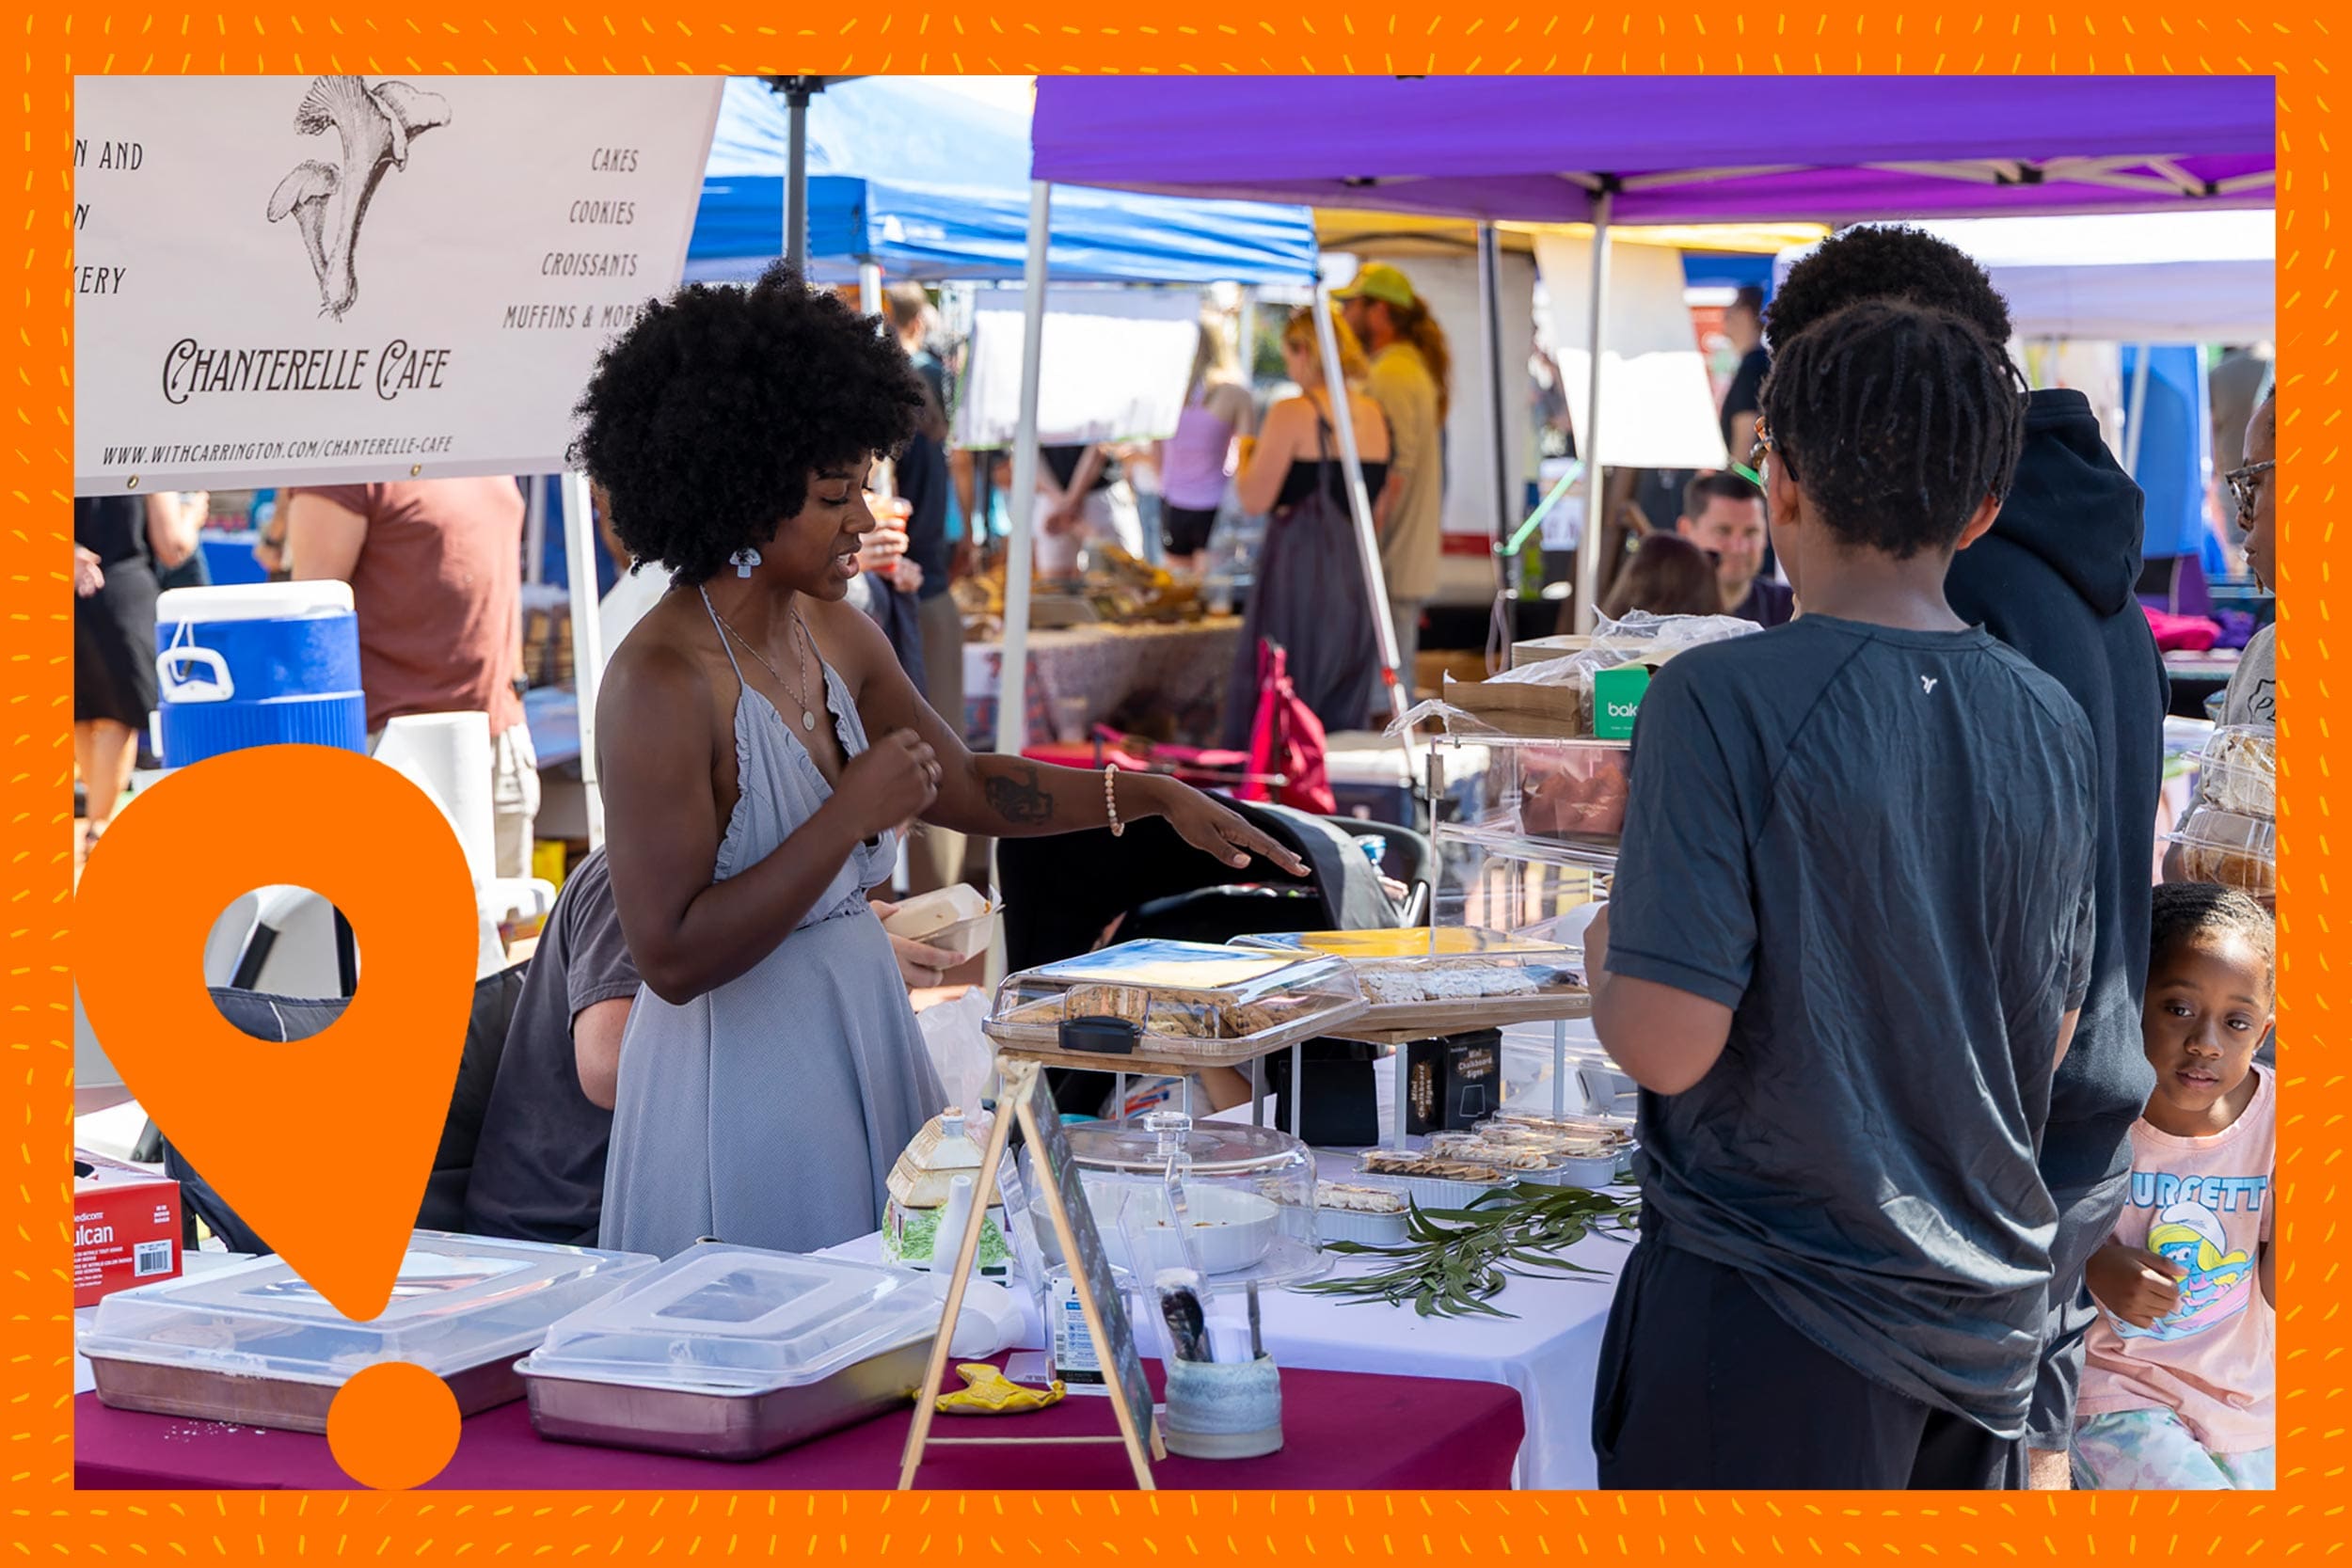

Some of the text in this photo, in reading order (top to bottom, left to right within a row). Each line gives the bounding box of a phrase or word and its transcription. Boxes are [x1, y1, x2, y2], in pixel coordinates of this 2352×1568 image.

[99, 141, 143, 170] AND
[591, 148, 639, 172] CAKES
[569, 200, 636, 225] COOKIES
[541, 252, 638, 277] CROISSANTS
[502, 305, 577, 329] MUFFINS
[581, 305, 594, 328] &
[162, 338, 452, 404] CHANTERELLE CAFE
[103, 436, 454, 466] WWW.WITHCARRINGTON.COM/CHANTERELLE-CAFE
